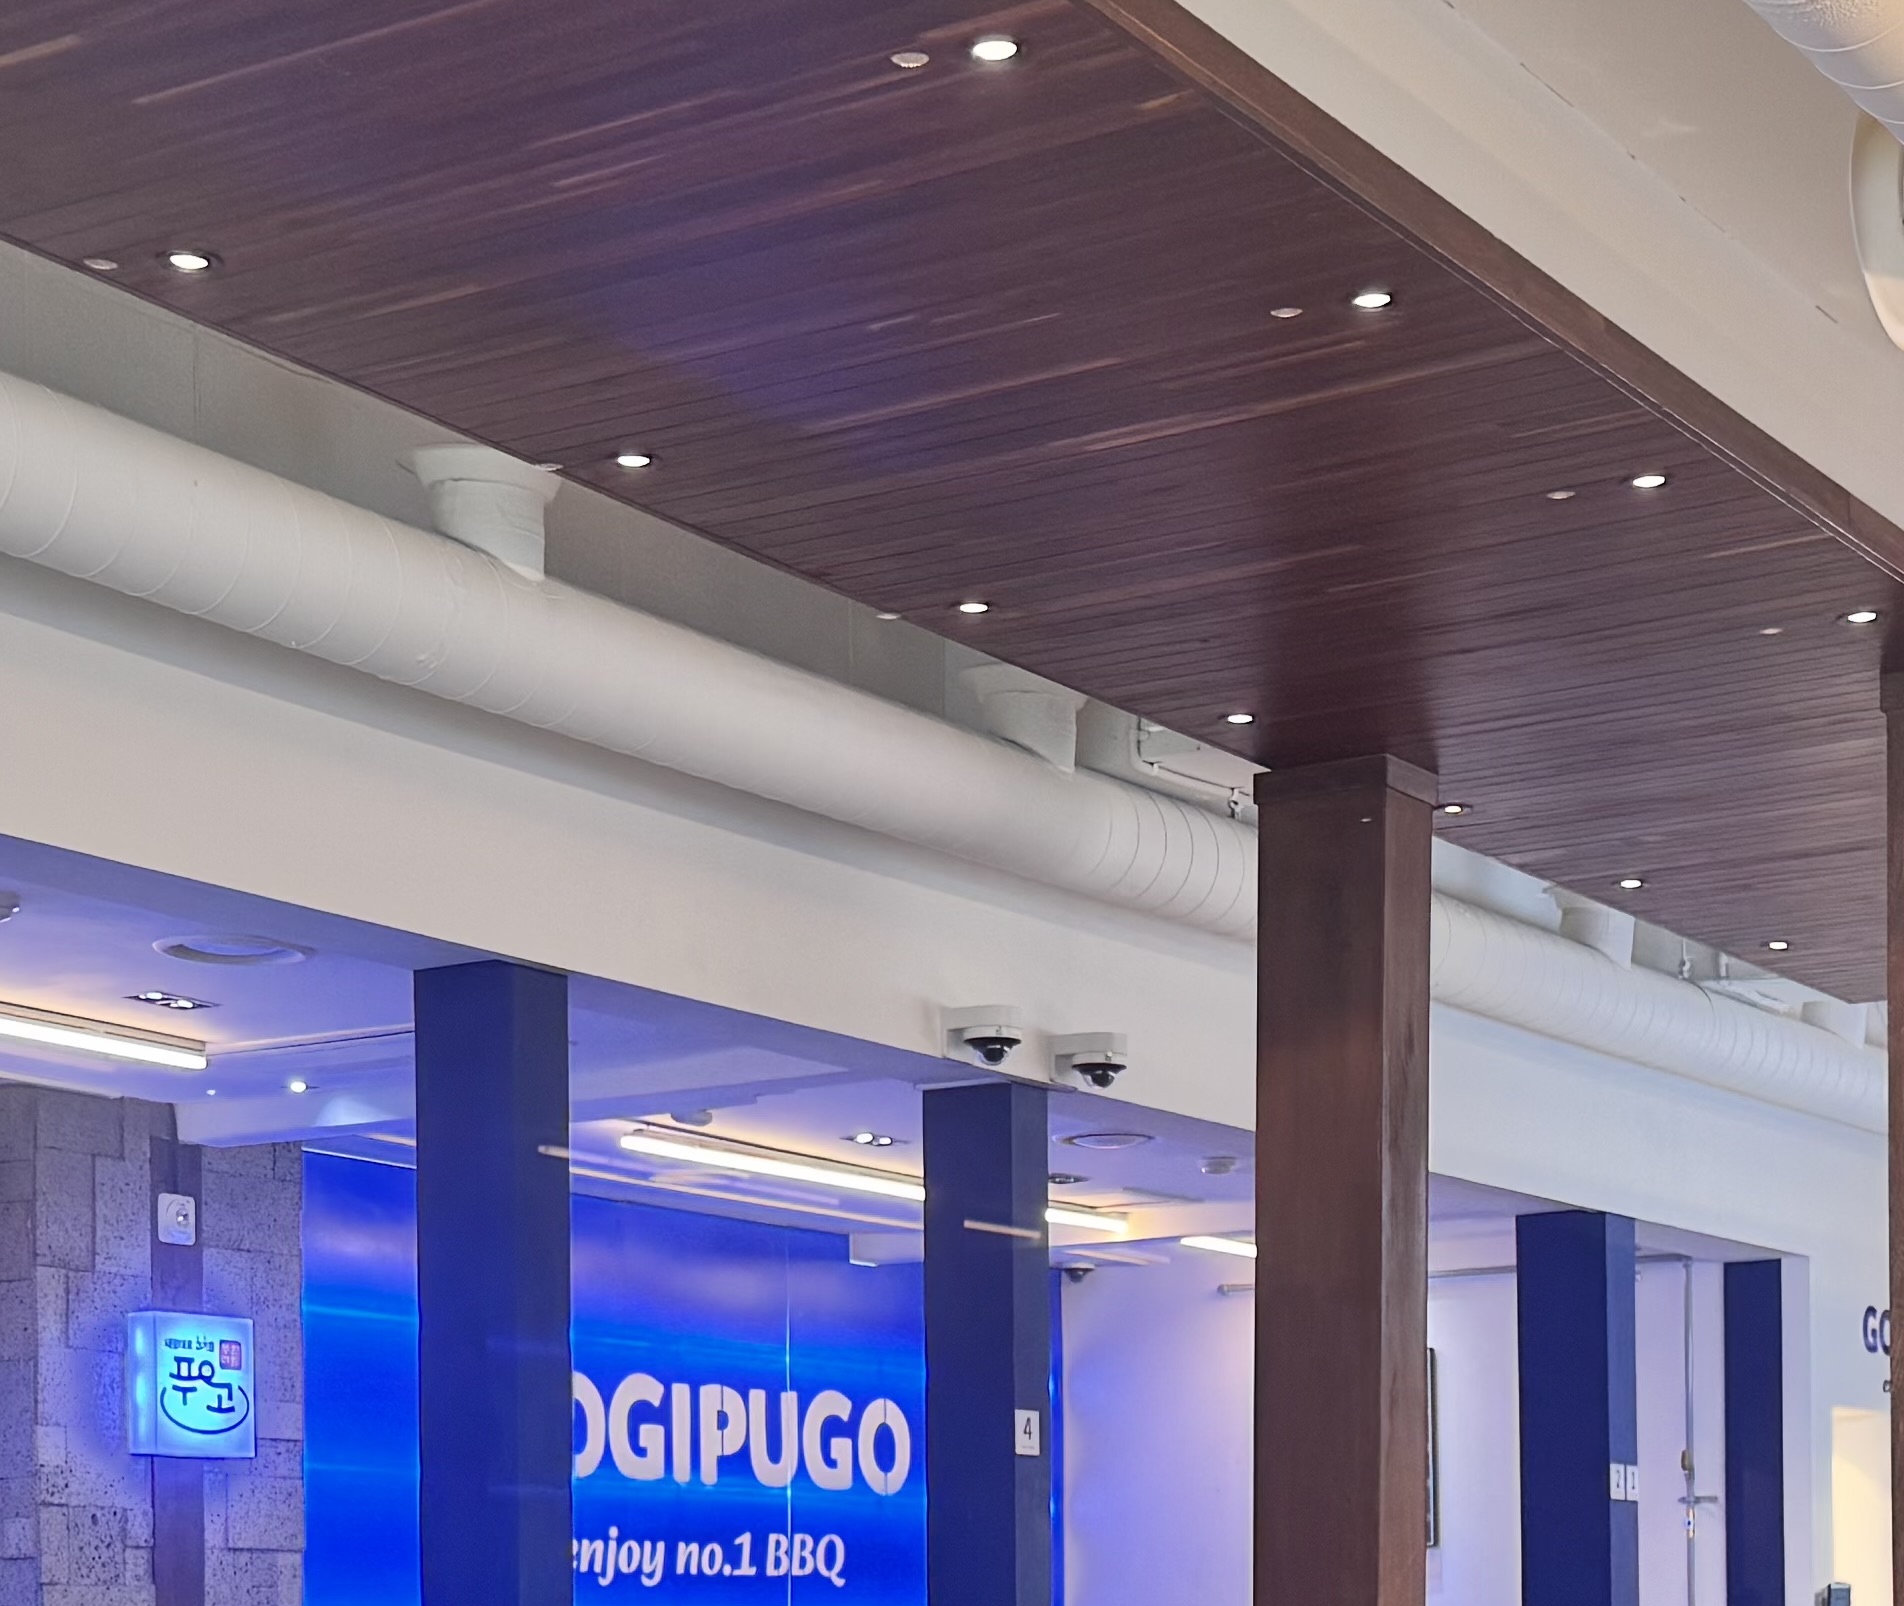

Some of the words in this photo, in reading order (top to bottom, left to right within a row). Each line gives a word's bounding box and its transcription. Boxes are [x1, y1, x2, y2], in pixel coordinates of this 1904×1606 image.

[1023, 1416, 1033, 1440] 4
[675, 1531, 757, 1577] no.1
[765, 1532, 846, 1588] BBQ
